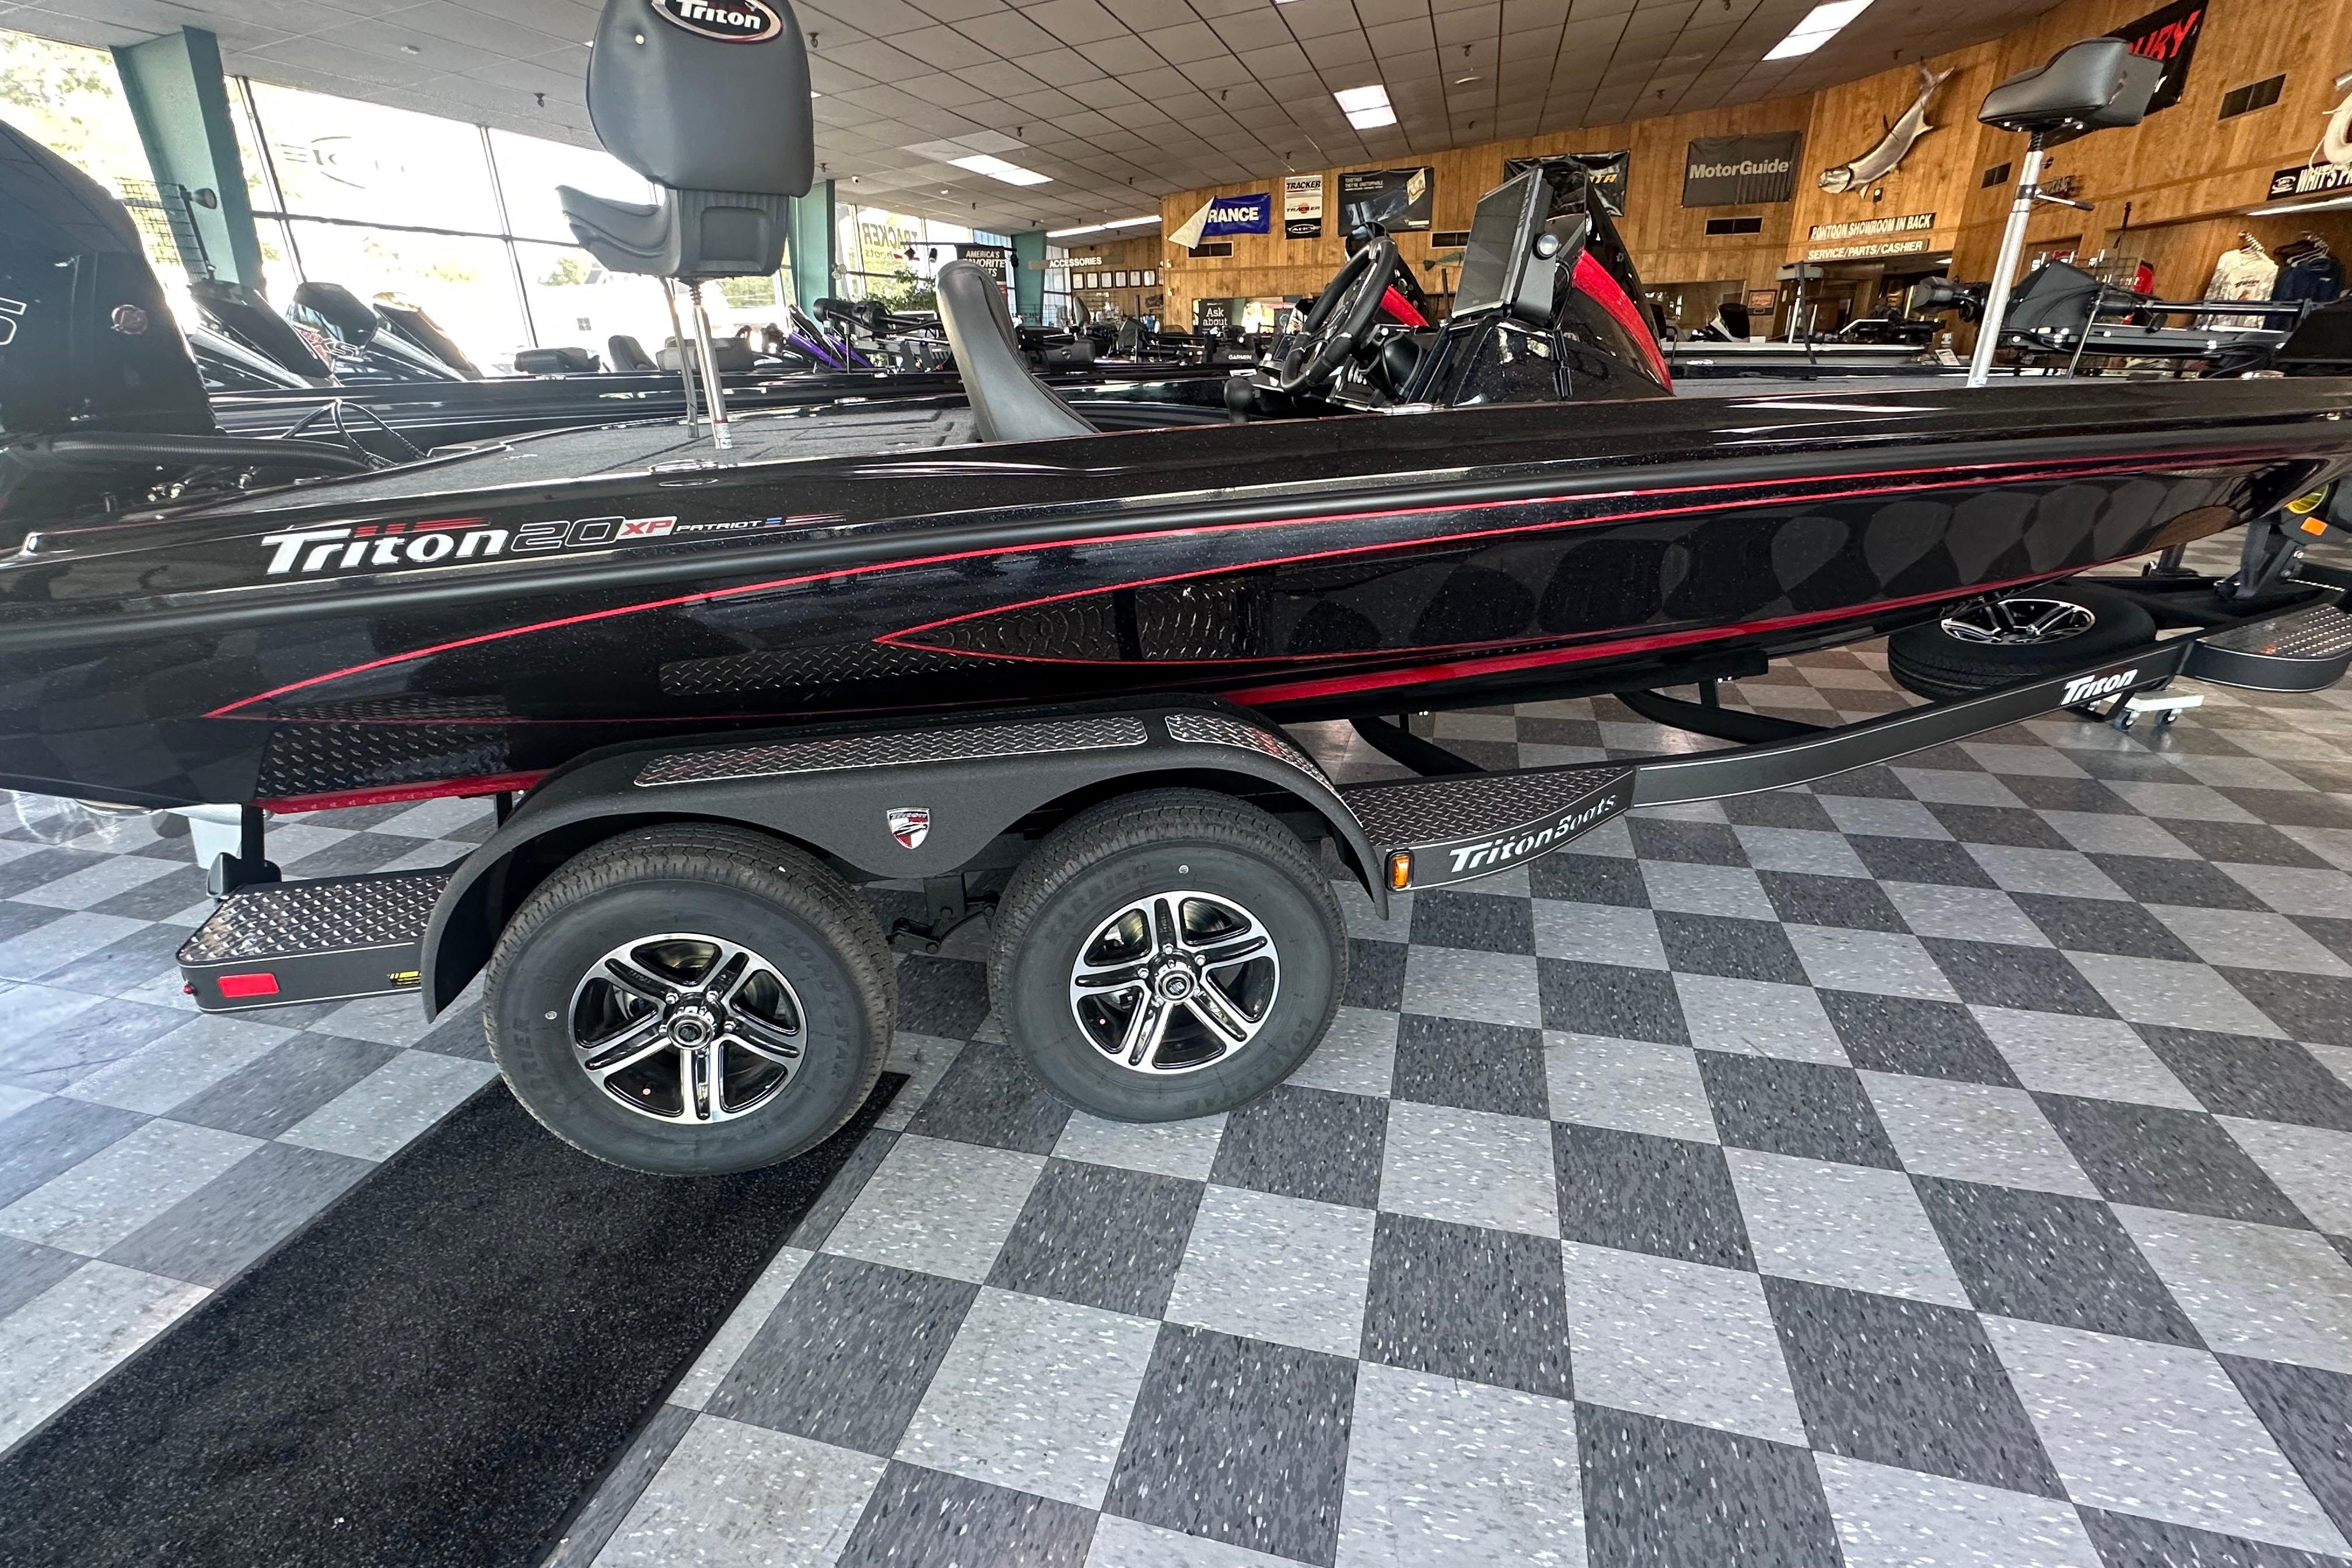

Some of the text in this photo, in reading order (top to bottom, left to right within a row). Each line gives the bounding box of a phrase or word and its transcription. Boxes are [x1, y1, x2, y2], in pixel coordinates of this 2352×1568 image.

[676, 0, 761, 29] Triton
[2129, 9, 2202, 60] URY
[1690, 159, 1789, 179] MotorGuide
[1286, 180, 1321, 190] TRACKER
[1811, 214, 1933, 240] PONTOON SHOWROOM IN BACK
[966, 250, 1000, 258] AMERICA'S
[1807, 240, 1923, 260] SERVICE/PARTS/CASHIER
[963, 258, 1006, 268] VORITE
[1049, 257, 1102, 268] ACCESSORIES
[1203, 317, 1228, 326] about
[1206, 307, 1224, 317] Ask
[261, 527, 509, 575] Triton
[676, 520, 762, 532] PATRIOT
[2060, 668, 2138, 706] Triton
[1449, 828, 1554, 873] Triton
